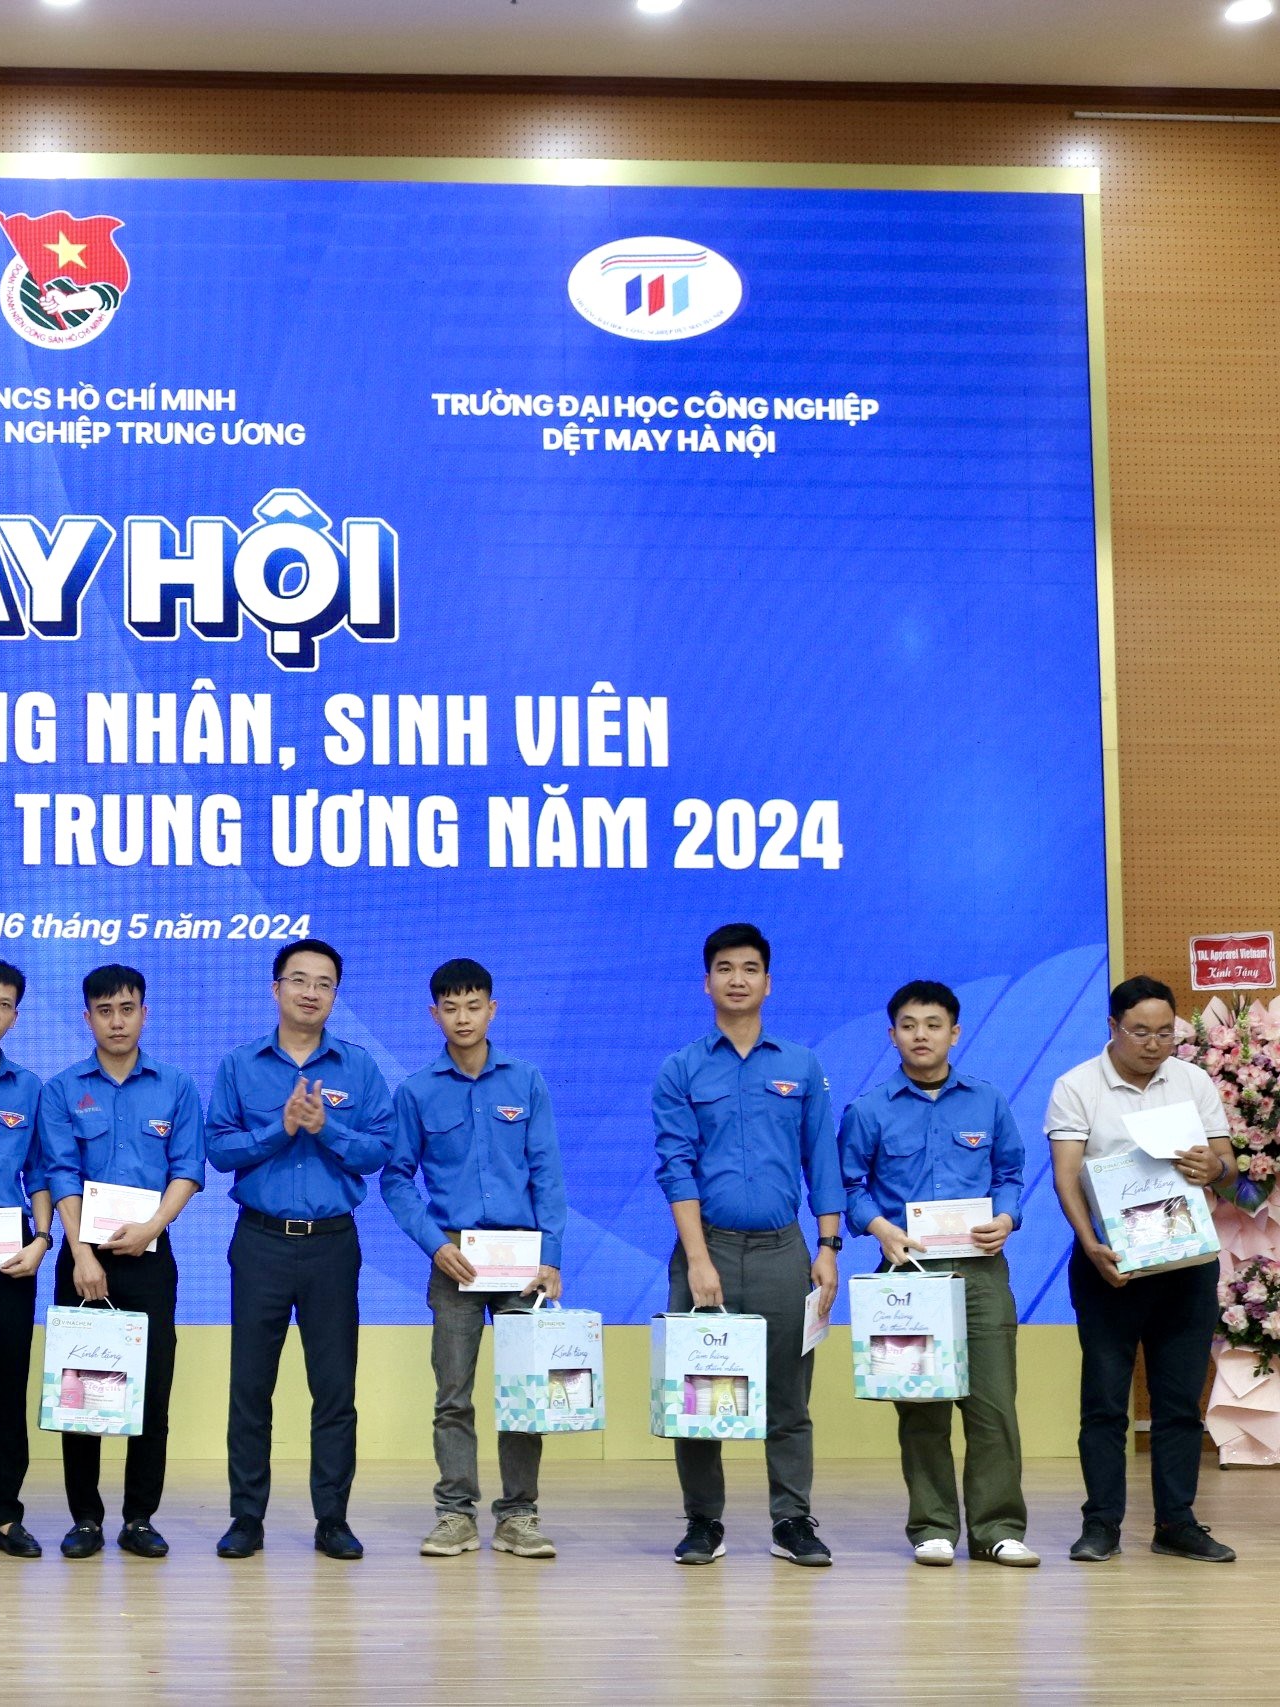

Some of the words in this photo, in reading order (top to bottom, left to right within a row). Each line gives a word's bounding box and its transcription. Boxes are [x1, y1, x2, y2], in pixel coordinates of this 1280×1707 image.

[56, 381, 101, 411] HỒ
[105, 382, 157, 411] CHÍ
[161, 388, 236, 412] MINH
[431, 387, 554, 417] TRƯỜNG
[556, 393, 610, 424] ĐẠI
[613, 395, 679, 424] HỌC
[683, 390, 770, 420] CÔNG
[773, 392, 880, 427] NGHIỆP
[5, 418, 111, 450] NGHIỆP
[115, 420, 216, 445] TRUNG
[221, 418, 306, 446] ƯƠNG
[542, 421, 601, 457] DỆT
[604, 428, 673, 452] MAY
[677, 423, 721, 453] HÀ
[725, 424, 776, 459] NỘI
[123, 487, 400, 672] HỘI
[86, 677, 296, 771] NHÂN,
[323, 693, 488, 766] SINH
[514, 680, 669, 767] VIÊN
[14, 793, 242, 867] TRUNG
[271, 787, 459, 868] ƯƠNG
[488, 783, 648, 869] NĂM
[673, 798, 844, 870] 2024
[31, 911, 122, 945] tháng
[127, 912, 148, 939] 5
[152, 912, 221, 939] năm
[226, 913, 311, 940] 2024
[1197, 949, 1209, 961] TAL
[1239, 947, 1267, 960] Vietnam
